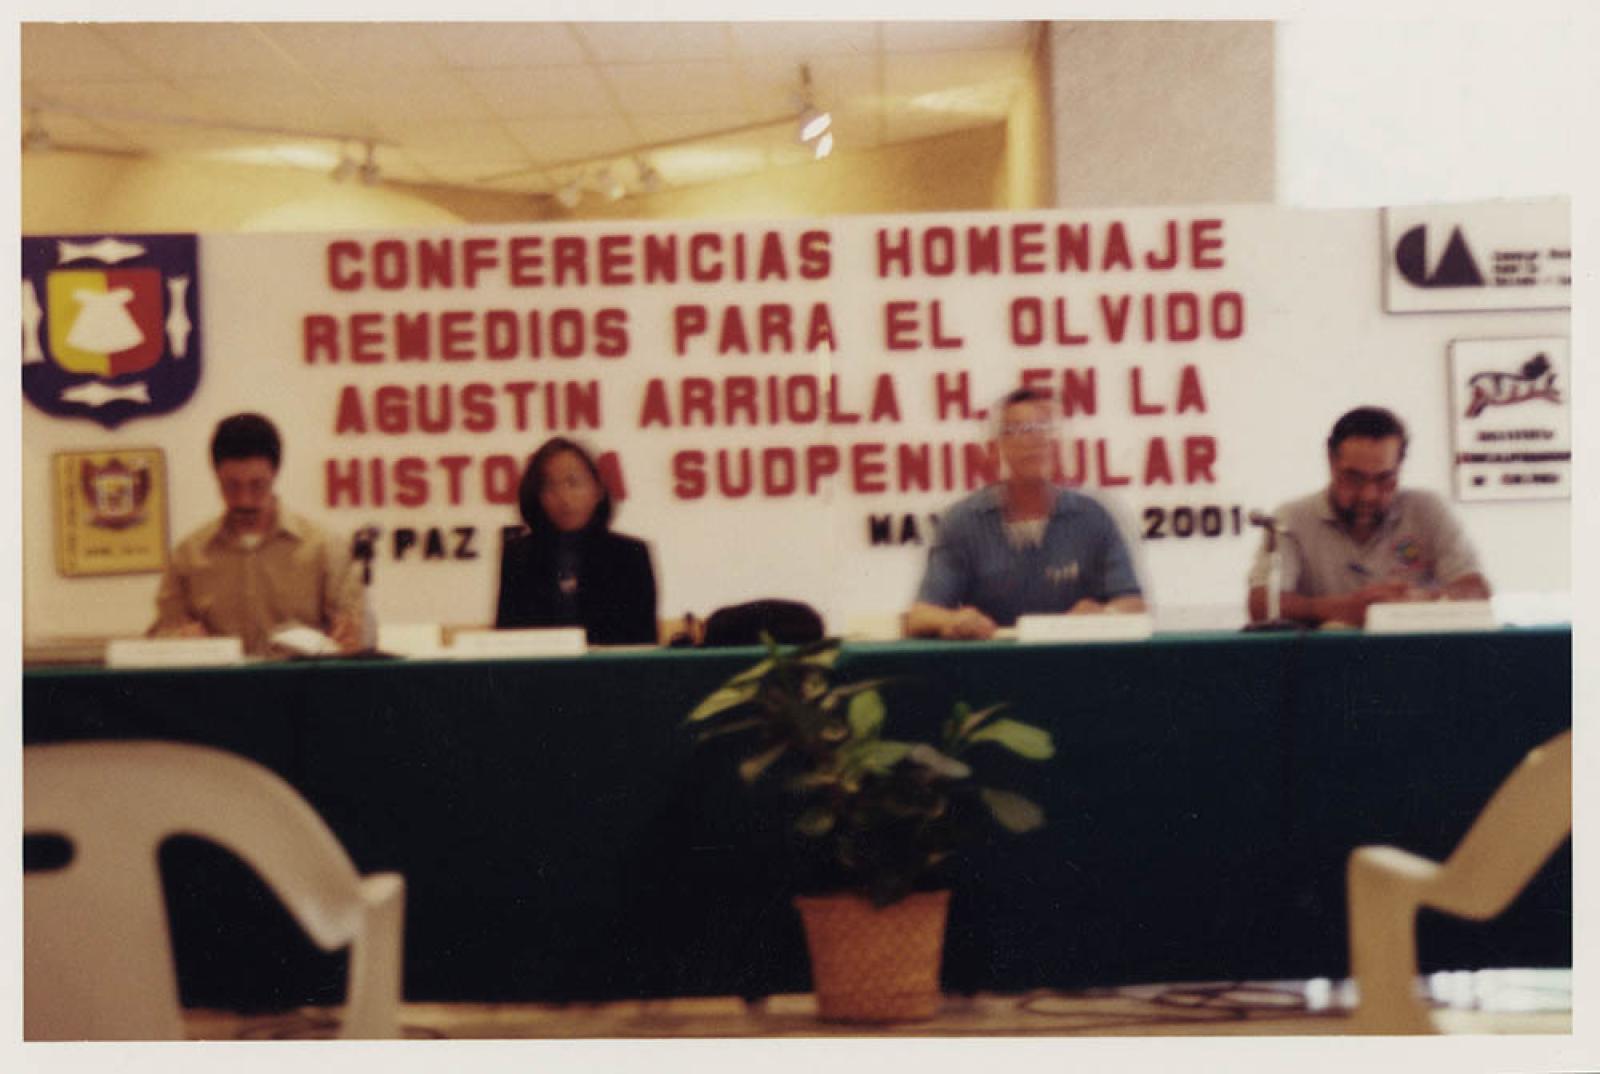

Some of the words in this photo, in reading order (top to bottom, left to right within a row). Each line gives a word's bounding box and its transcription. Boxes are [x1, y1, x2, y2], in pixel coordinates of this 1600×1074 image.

[327, 230, 831, 292] CONFERENCIAS
[876, 219, 1224, 278] HOMENAJE
[303, 307, 630, 365] REMEDIOS
[673, 302, 837, 355] PARA
[885, 301, 963, 351] EL
[1010, 291, 1244, 347] OLVIDO
[335, 379, 601, 436] AGUSTIN
[639, 373, 901, 427] ARRIOLA
[935, 371, 989, 421] H.
[1130, 365, 1206, 416] LA
[325, 451, 628, 508] HISTOA
[671, 434, 1217, 499] SUDPENINULAR
[391, 526, 478, 561] PAZ
[1142, 505, 1241, 540] 2001
